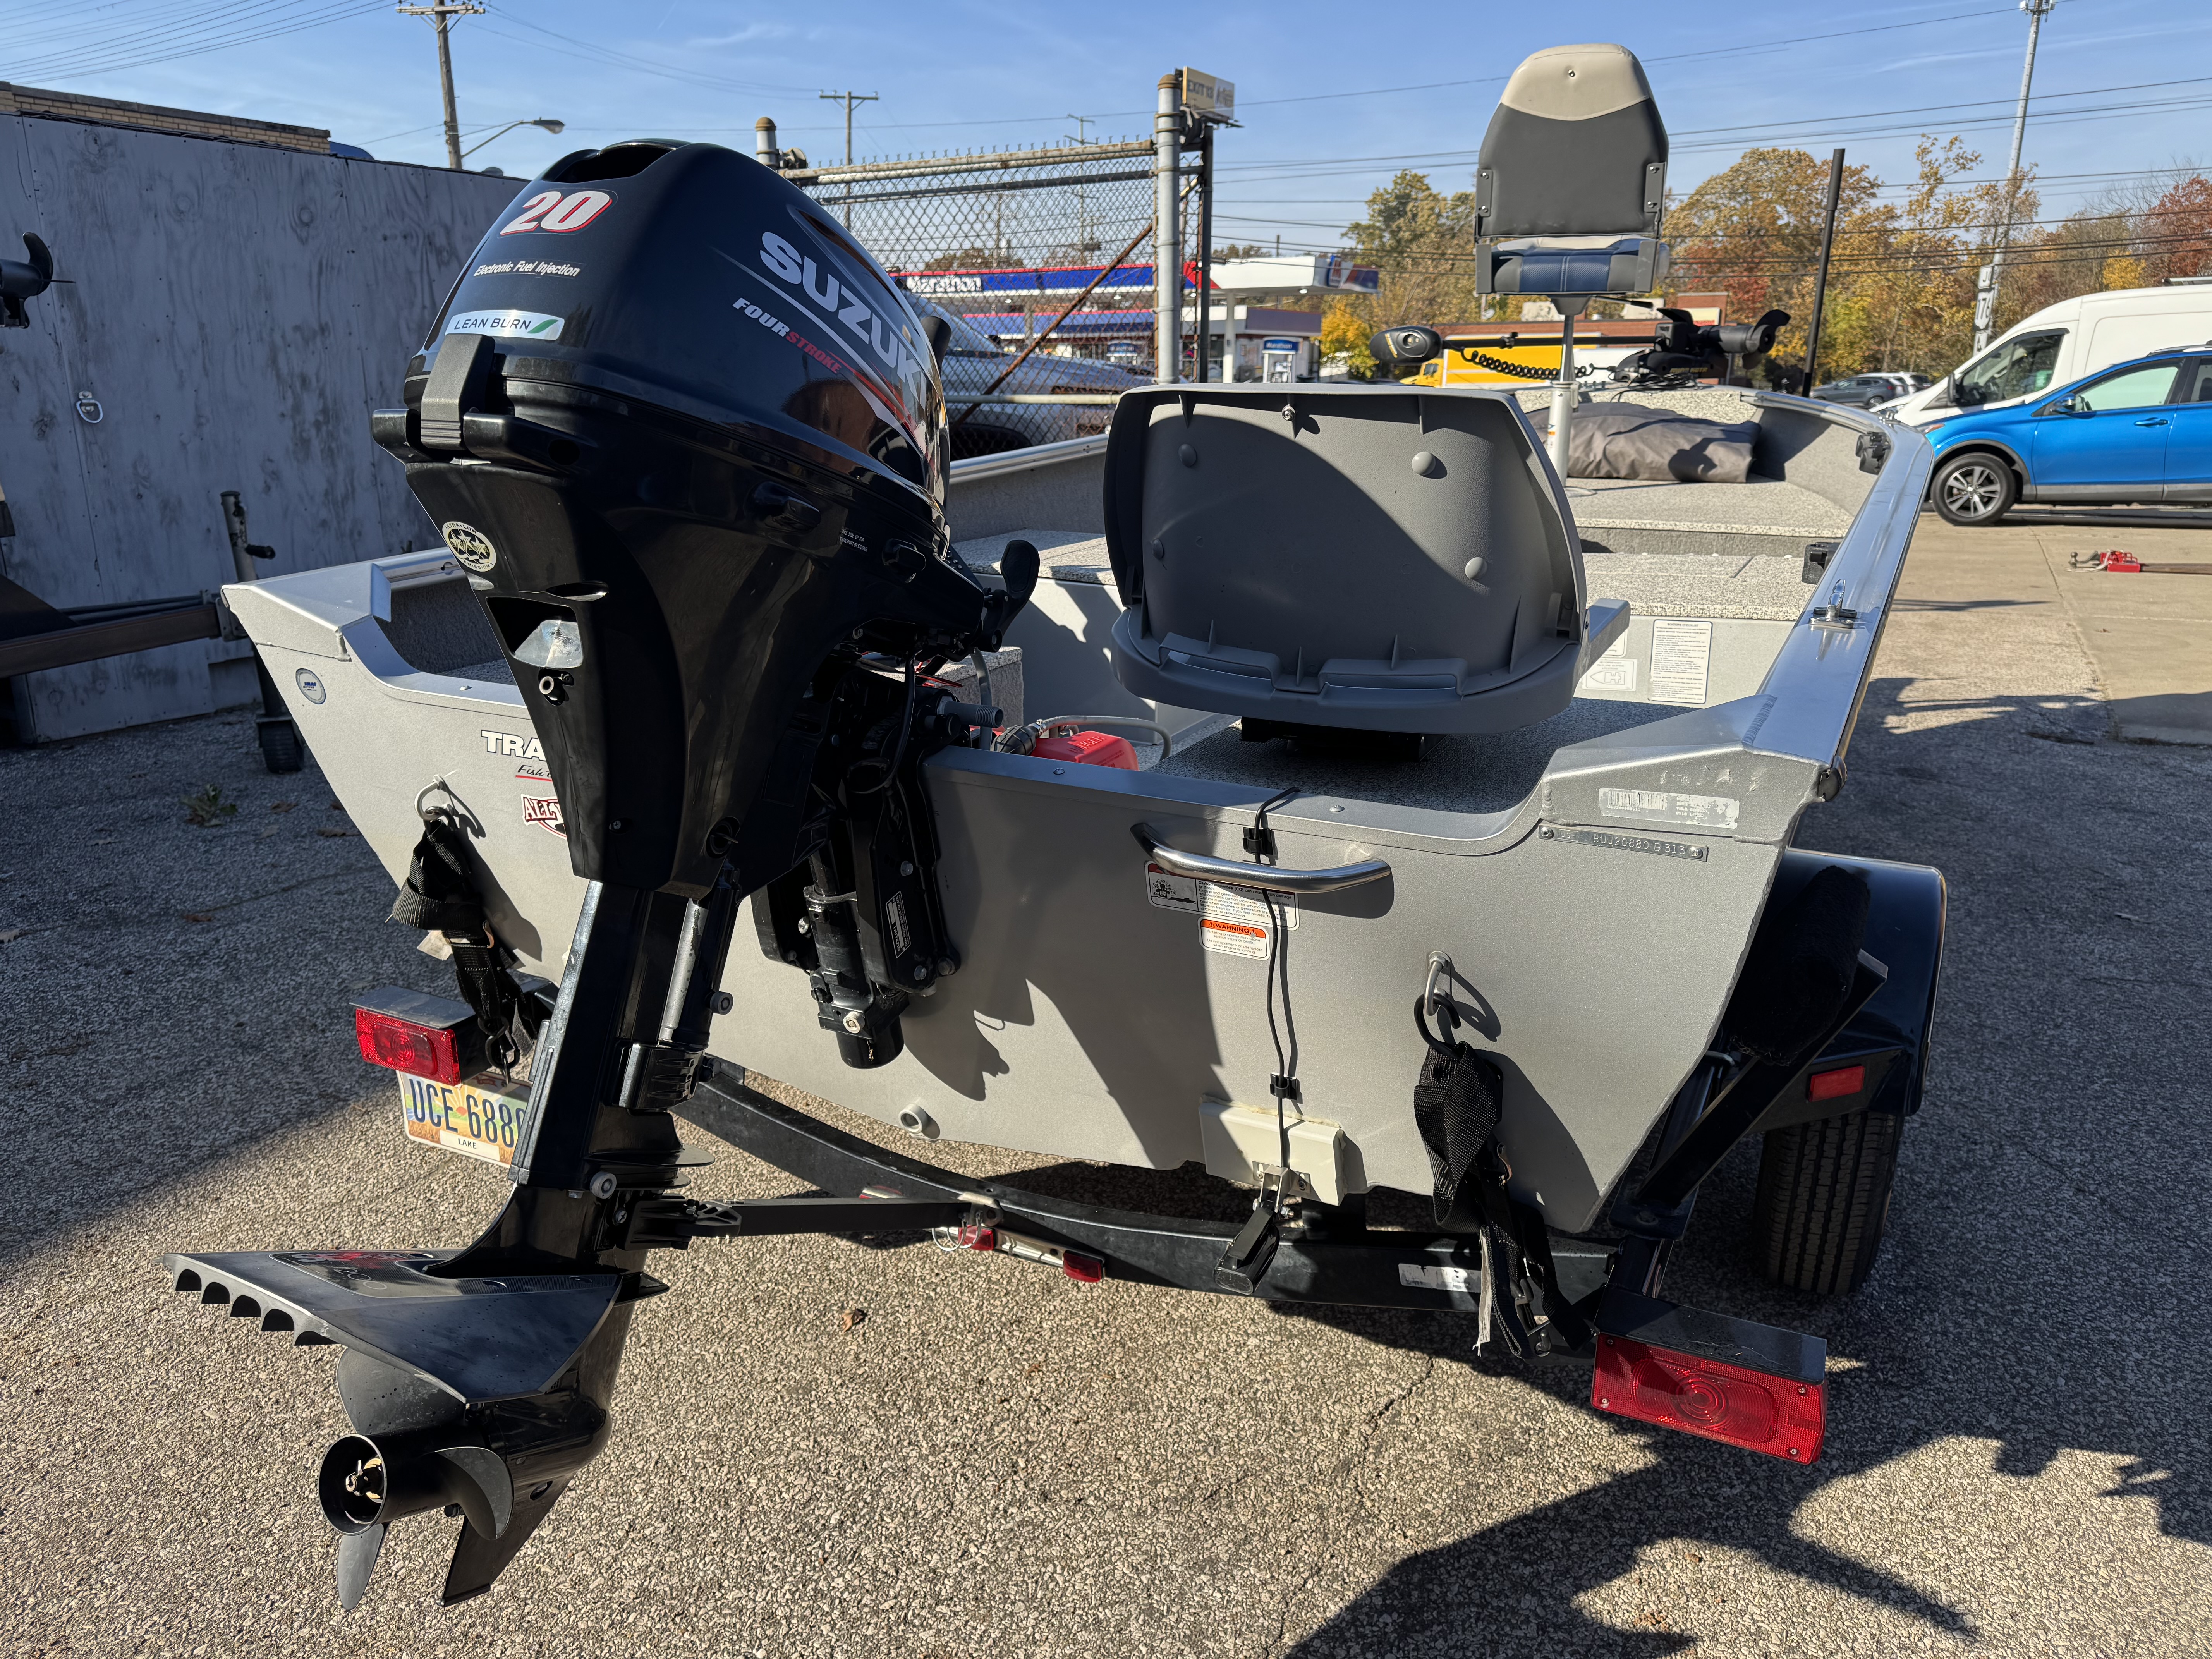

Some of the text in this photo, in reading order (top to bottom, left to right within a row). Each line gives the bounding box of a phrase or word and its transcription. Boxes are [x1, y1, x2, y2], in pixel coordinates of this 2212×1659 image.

[499, 191, 613, 236] 20
[473, 261, 580, 276] Electronic Fuel Injection
[454, 318, 531, 330] LEAN BURN
[760, 232, 927, 410] SUZUKI
[732, 297, 842, 374] FOUR STROKE
[518, 765, 544, 776] Fish
[1215, 923, 1249, 933] WARNING
[409, 1079, 458, 1133] UCE
[458, 1138, 477, 1149] LAKE
